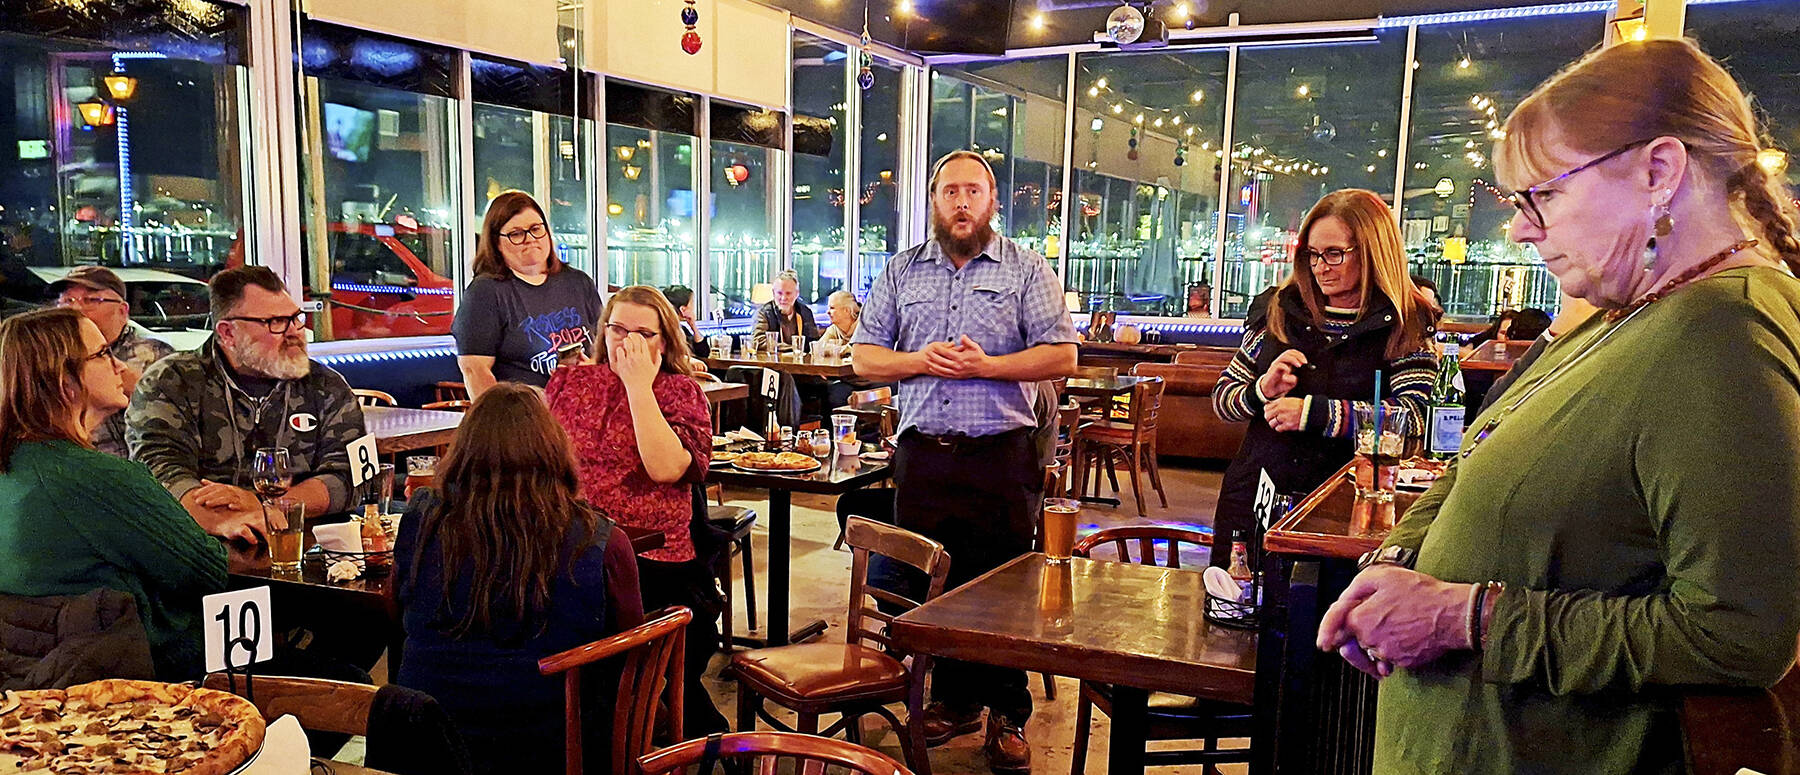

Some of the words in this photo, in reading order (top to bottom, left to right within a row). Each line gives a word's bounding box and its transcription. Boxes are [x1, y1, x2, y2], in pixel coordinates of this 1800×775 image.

[358, 445, 370, 473] 9
[1259, 481, 1271, 518] 12
[215, 600, 261, 657] 10
